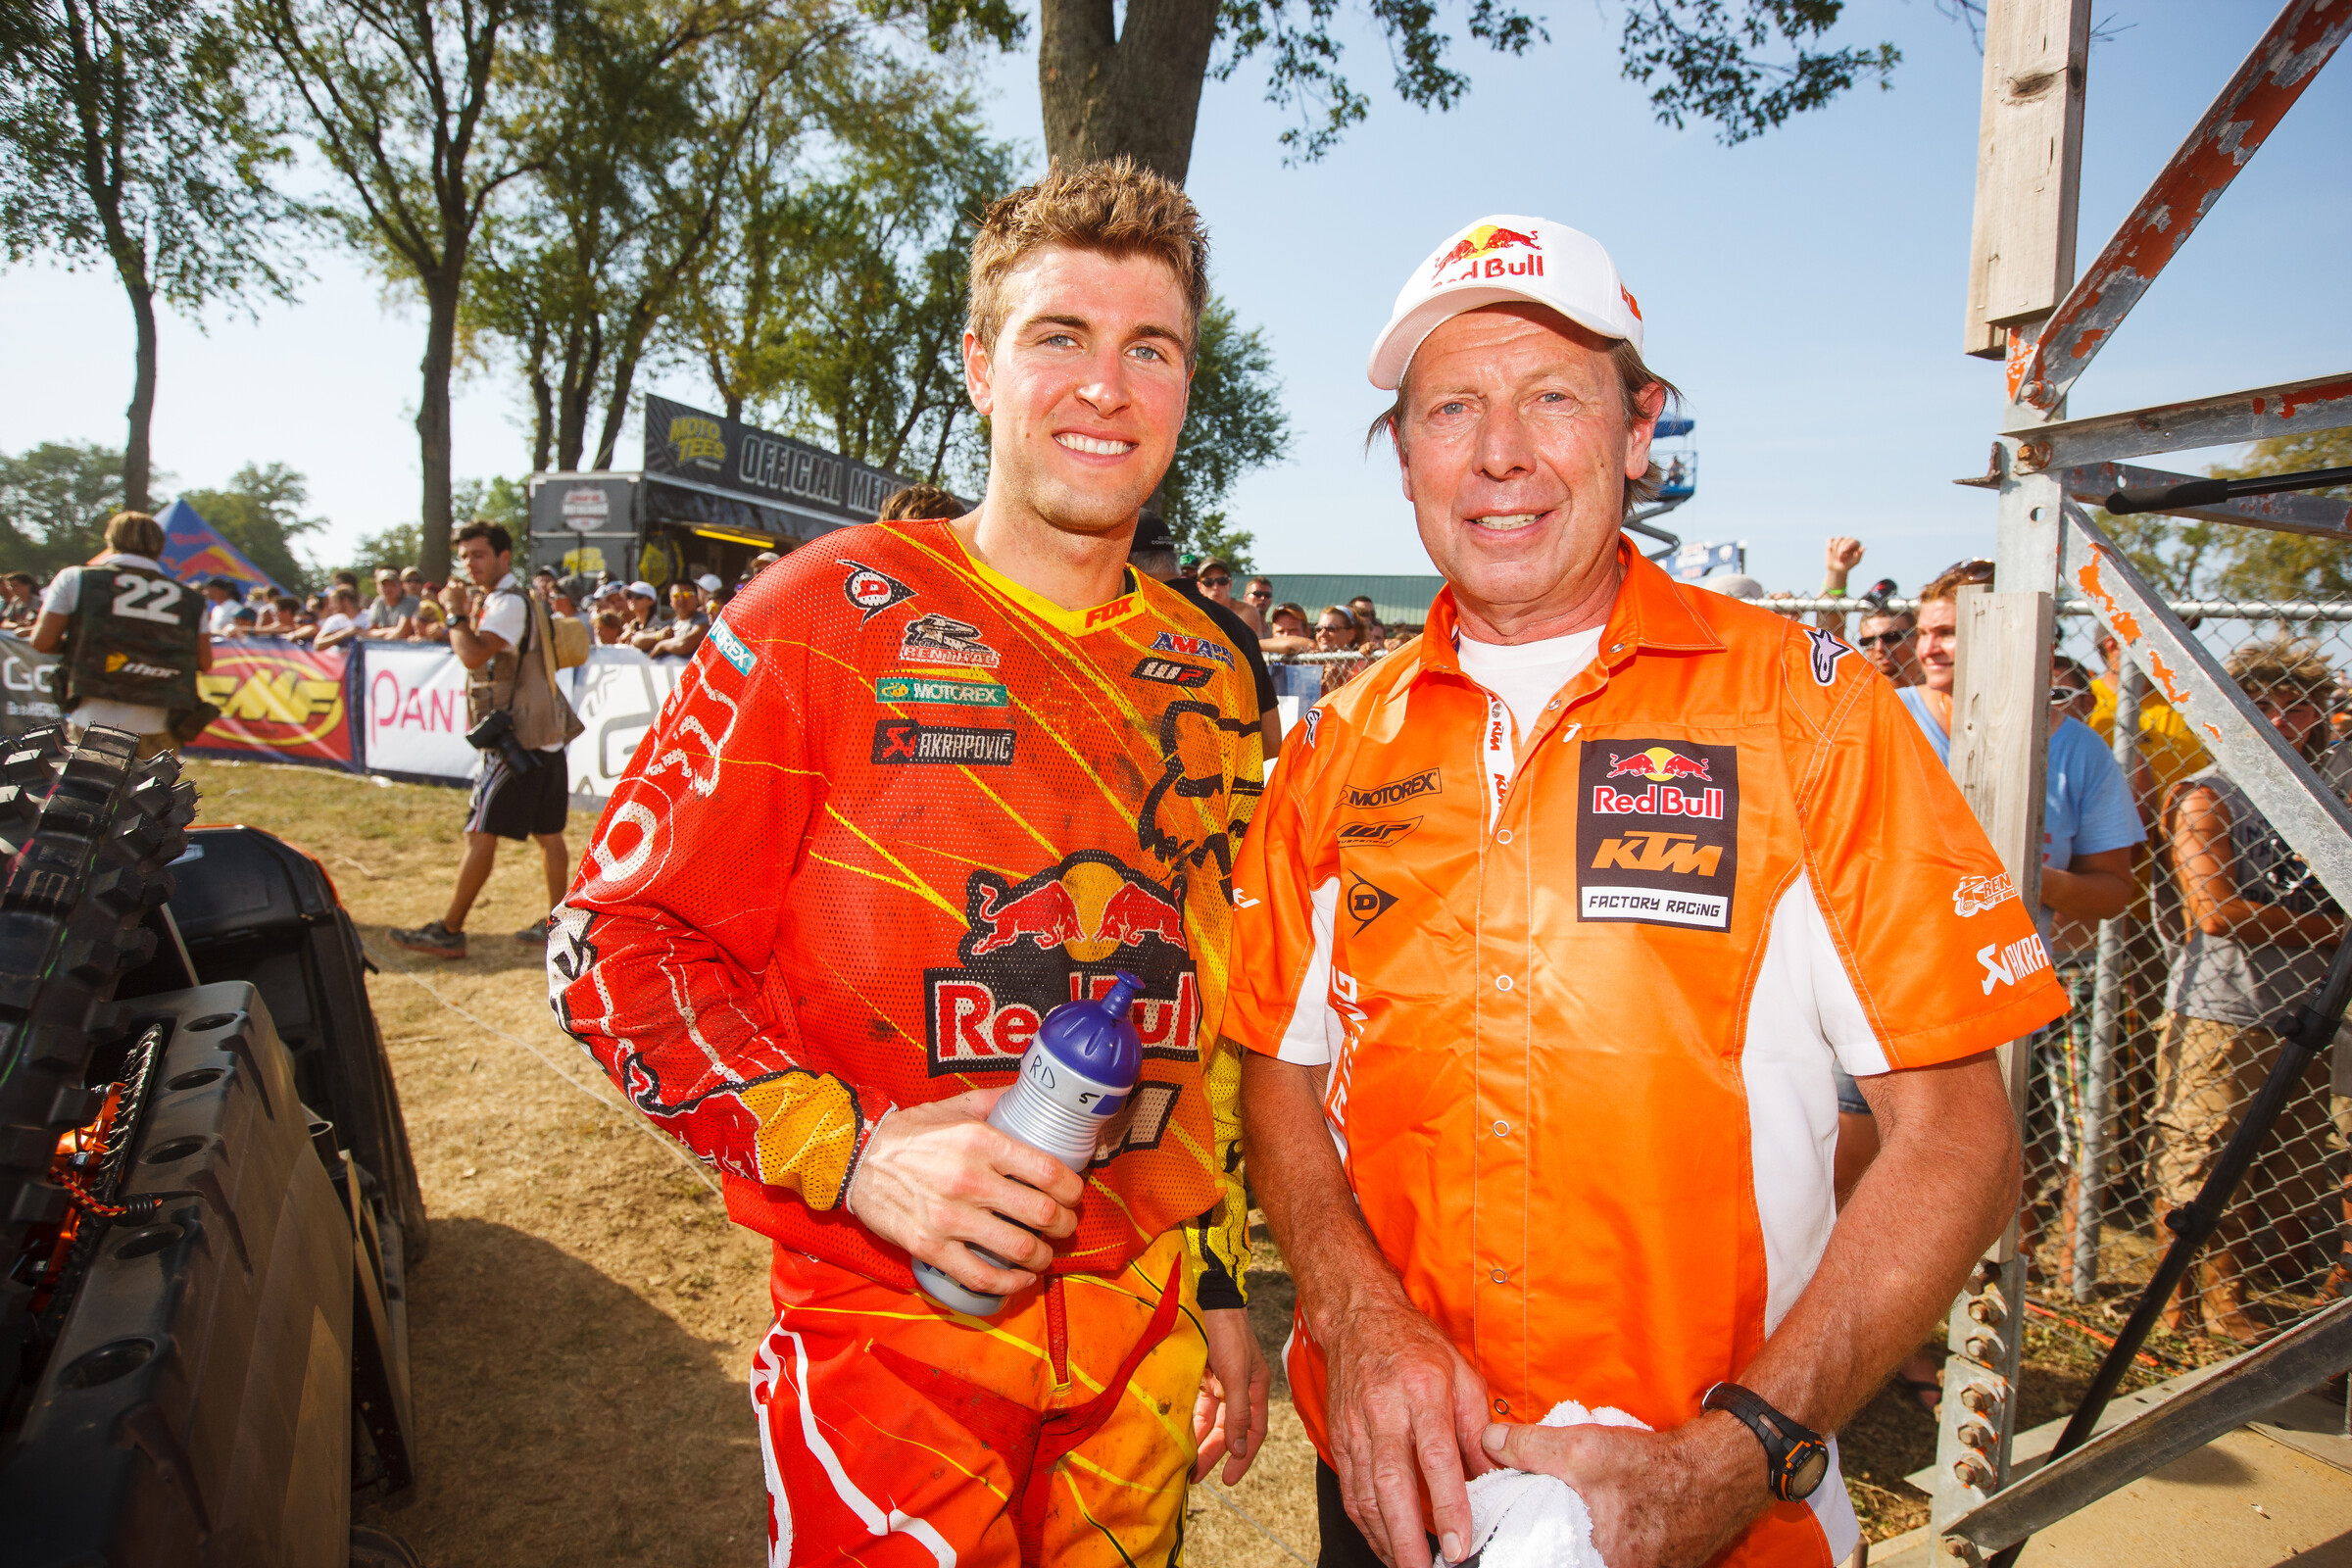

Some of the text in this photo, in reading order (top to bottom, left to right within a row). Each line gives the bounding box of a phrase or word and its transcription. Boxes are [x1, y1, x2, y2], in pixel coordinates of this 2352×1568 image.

[1485, 254, 1544, 278] Bull
[678, 437, 725, 464] TEES
[739, 434, 845, 506] OFFICIAL
[112, 573, 181, 625] 22
[1085, 596, 1135, 628] FOX
[901, 645, 999, 666] RENTHAL
[1150, 631, 1214, 661] AMA
[121, 662, 181, 678] thor
[197, 669, 342, 725] FMF
[913, 683, 1000, 703] MOTOREX
[1349, 772, 1436, 807] MOTOREX
[1592, 784, 1723, 820] Red Bull
[1591, 830, 1723, 877] KTM
[1589, 896, 1661, 911] FACTORY
[1029, 1054, 1056, 1090] RD
